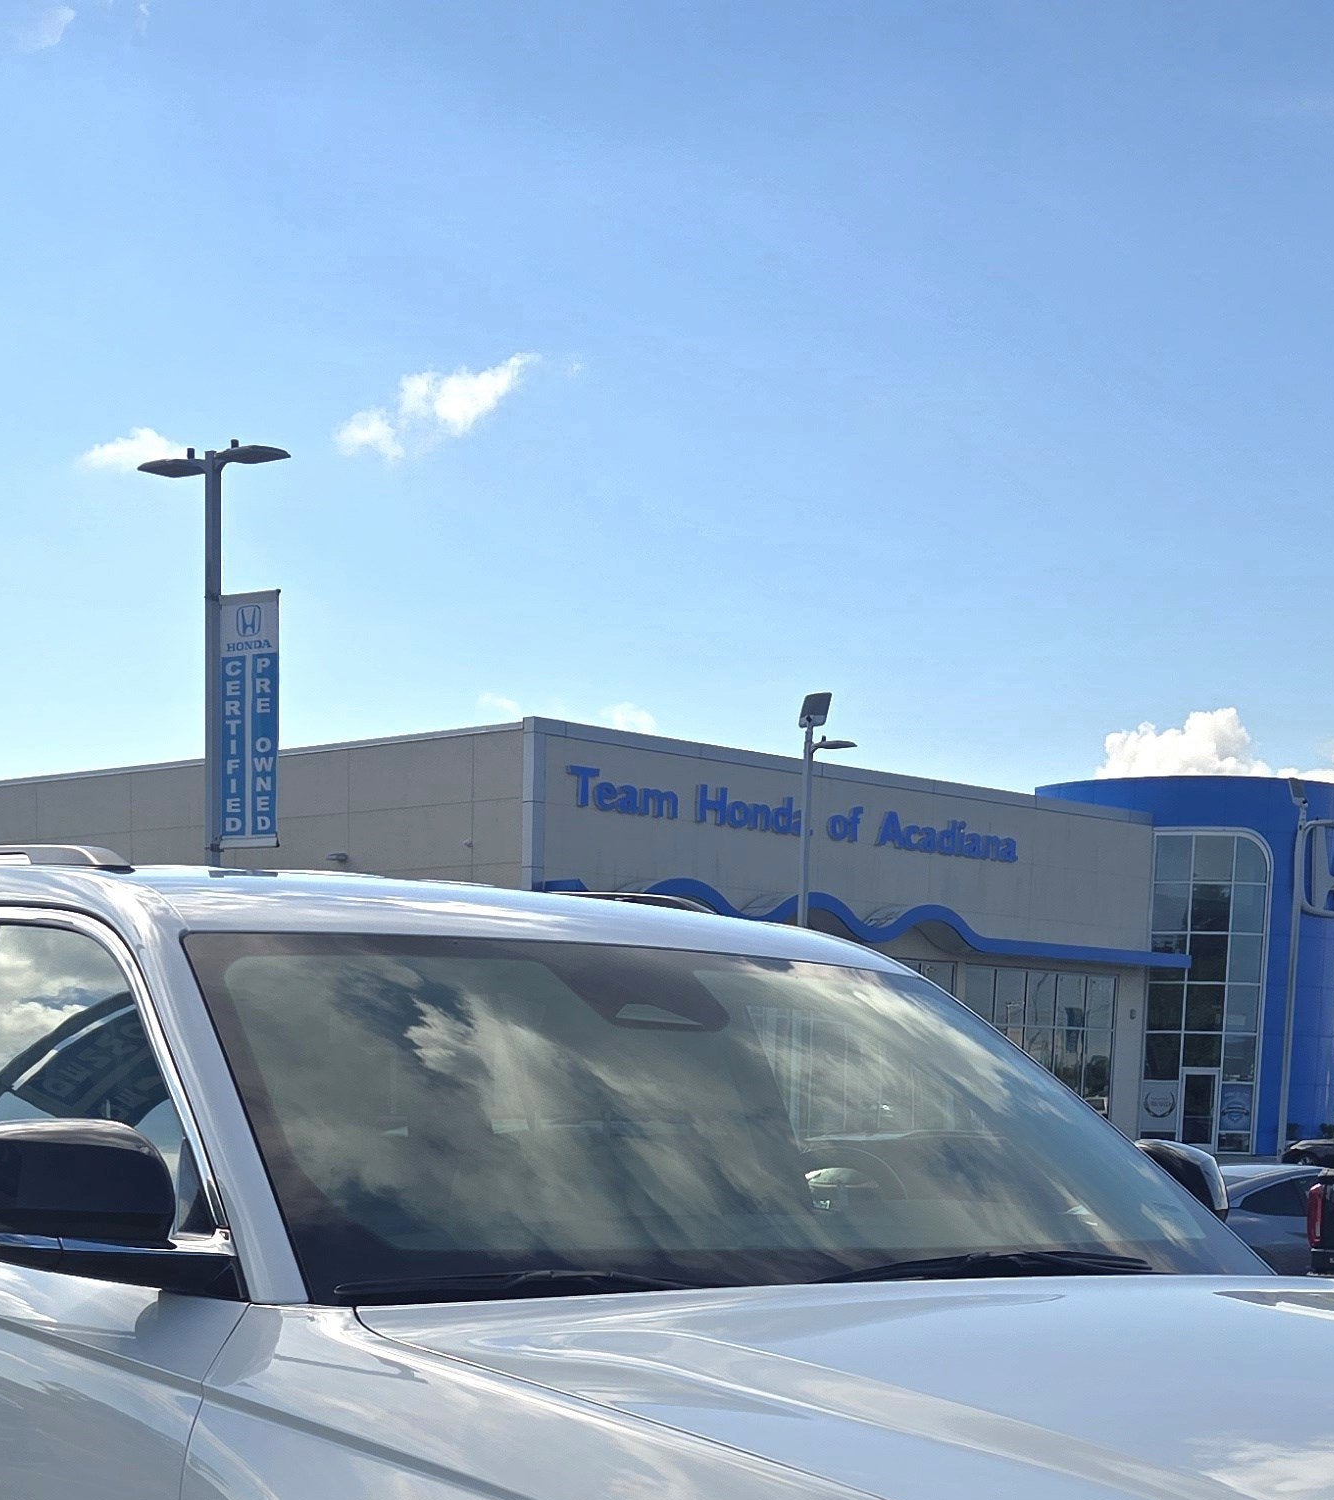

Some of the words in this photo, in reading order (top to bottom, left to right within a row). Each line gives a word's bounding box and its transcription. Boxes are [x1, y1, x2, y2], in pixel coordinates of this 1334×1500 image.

[226, 639, 272, 652] HONDA
[255, 657, 271, 714] PRE
[224, 660, 243, 832] CERTIFIED
[253, 736, 273, 831] OWNED
[567, 765, 679, 820] Team
[826, 806, 864, 843] of
[873, 810, 1019, 863] Acadiana
